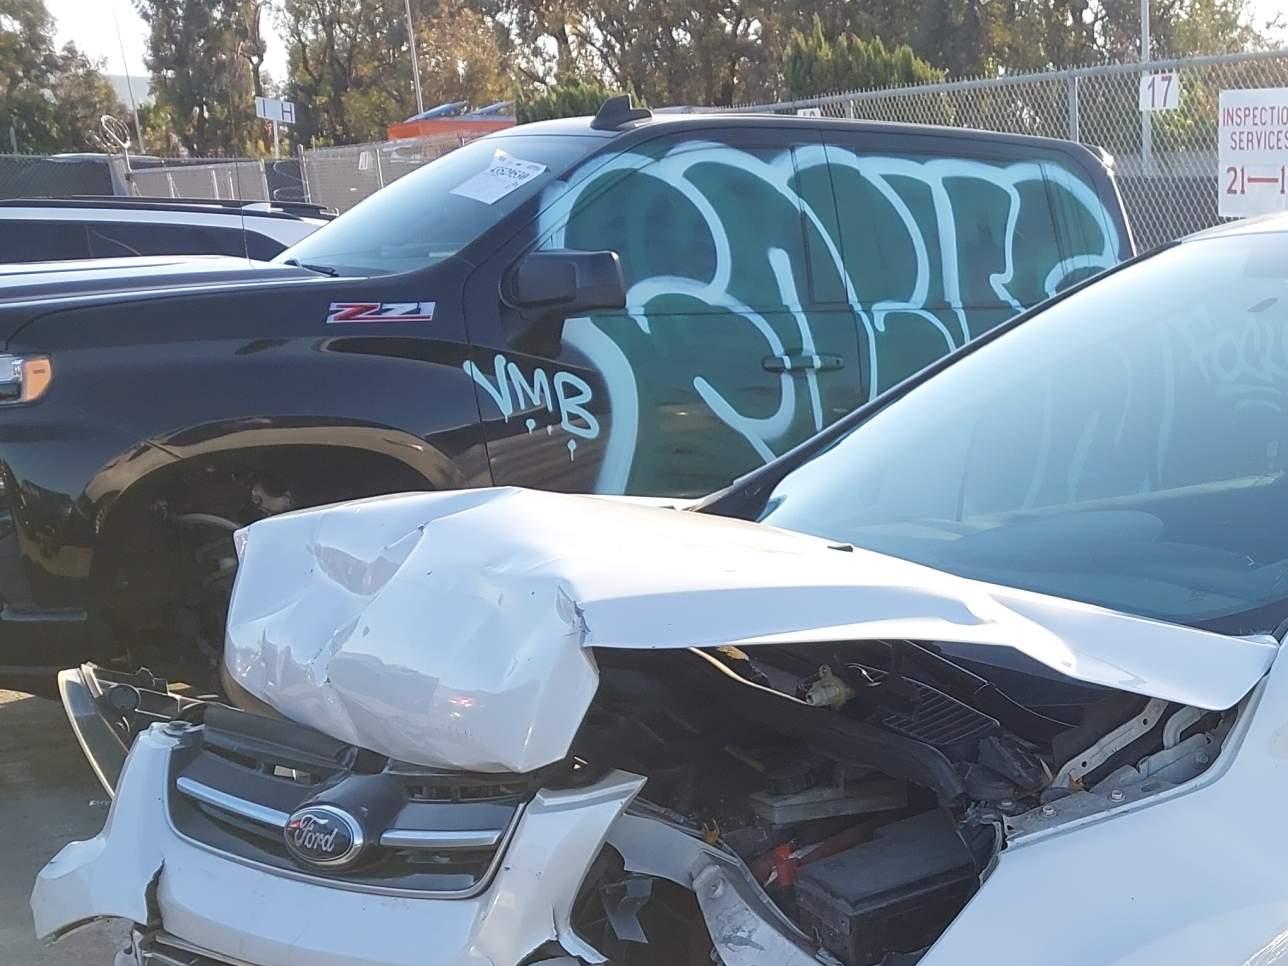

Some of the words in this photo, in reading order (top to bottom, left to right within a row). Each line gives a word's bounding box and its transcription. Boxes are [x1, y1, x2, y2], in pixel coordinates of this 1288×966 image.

[1147, 75, 1172, 108] 17
[462, 354, 600, 440] VMB
[294, 814, 338, 853] Ford
